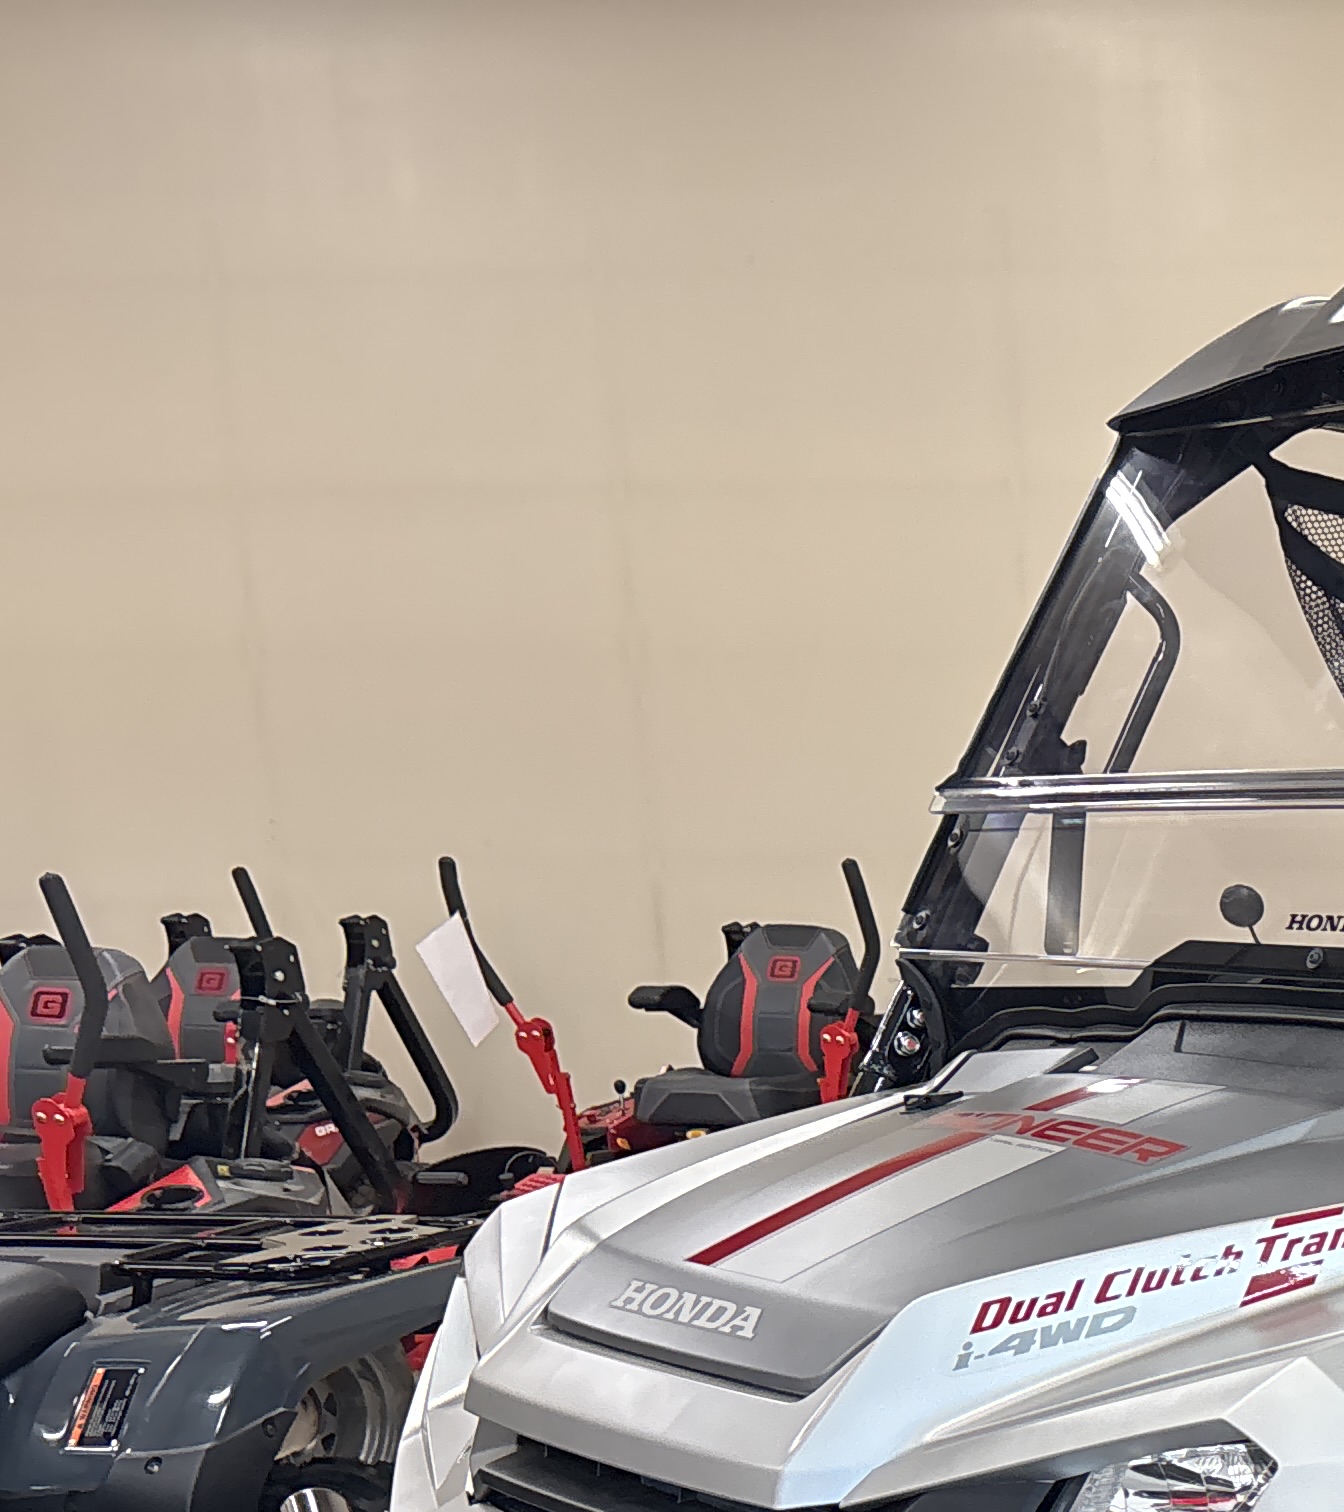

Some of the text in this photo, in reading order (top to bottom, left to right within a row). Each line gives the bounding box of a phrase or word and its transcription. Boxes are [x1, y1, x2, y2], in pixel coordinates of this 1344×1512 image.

[610, 1279, 763, 1339] HONDA
[969, 1279, 1085, 1335] Dual
[1094, 1244, 1244, 1305] Clutch
[952, 1305, 1138, 1371] i-4WD
